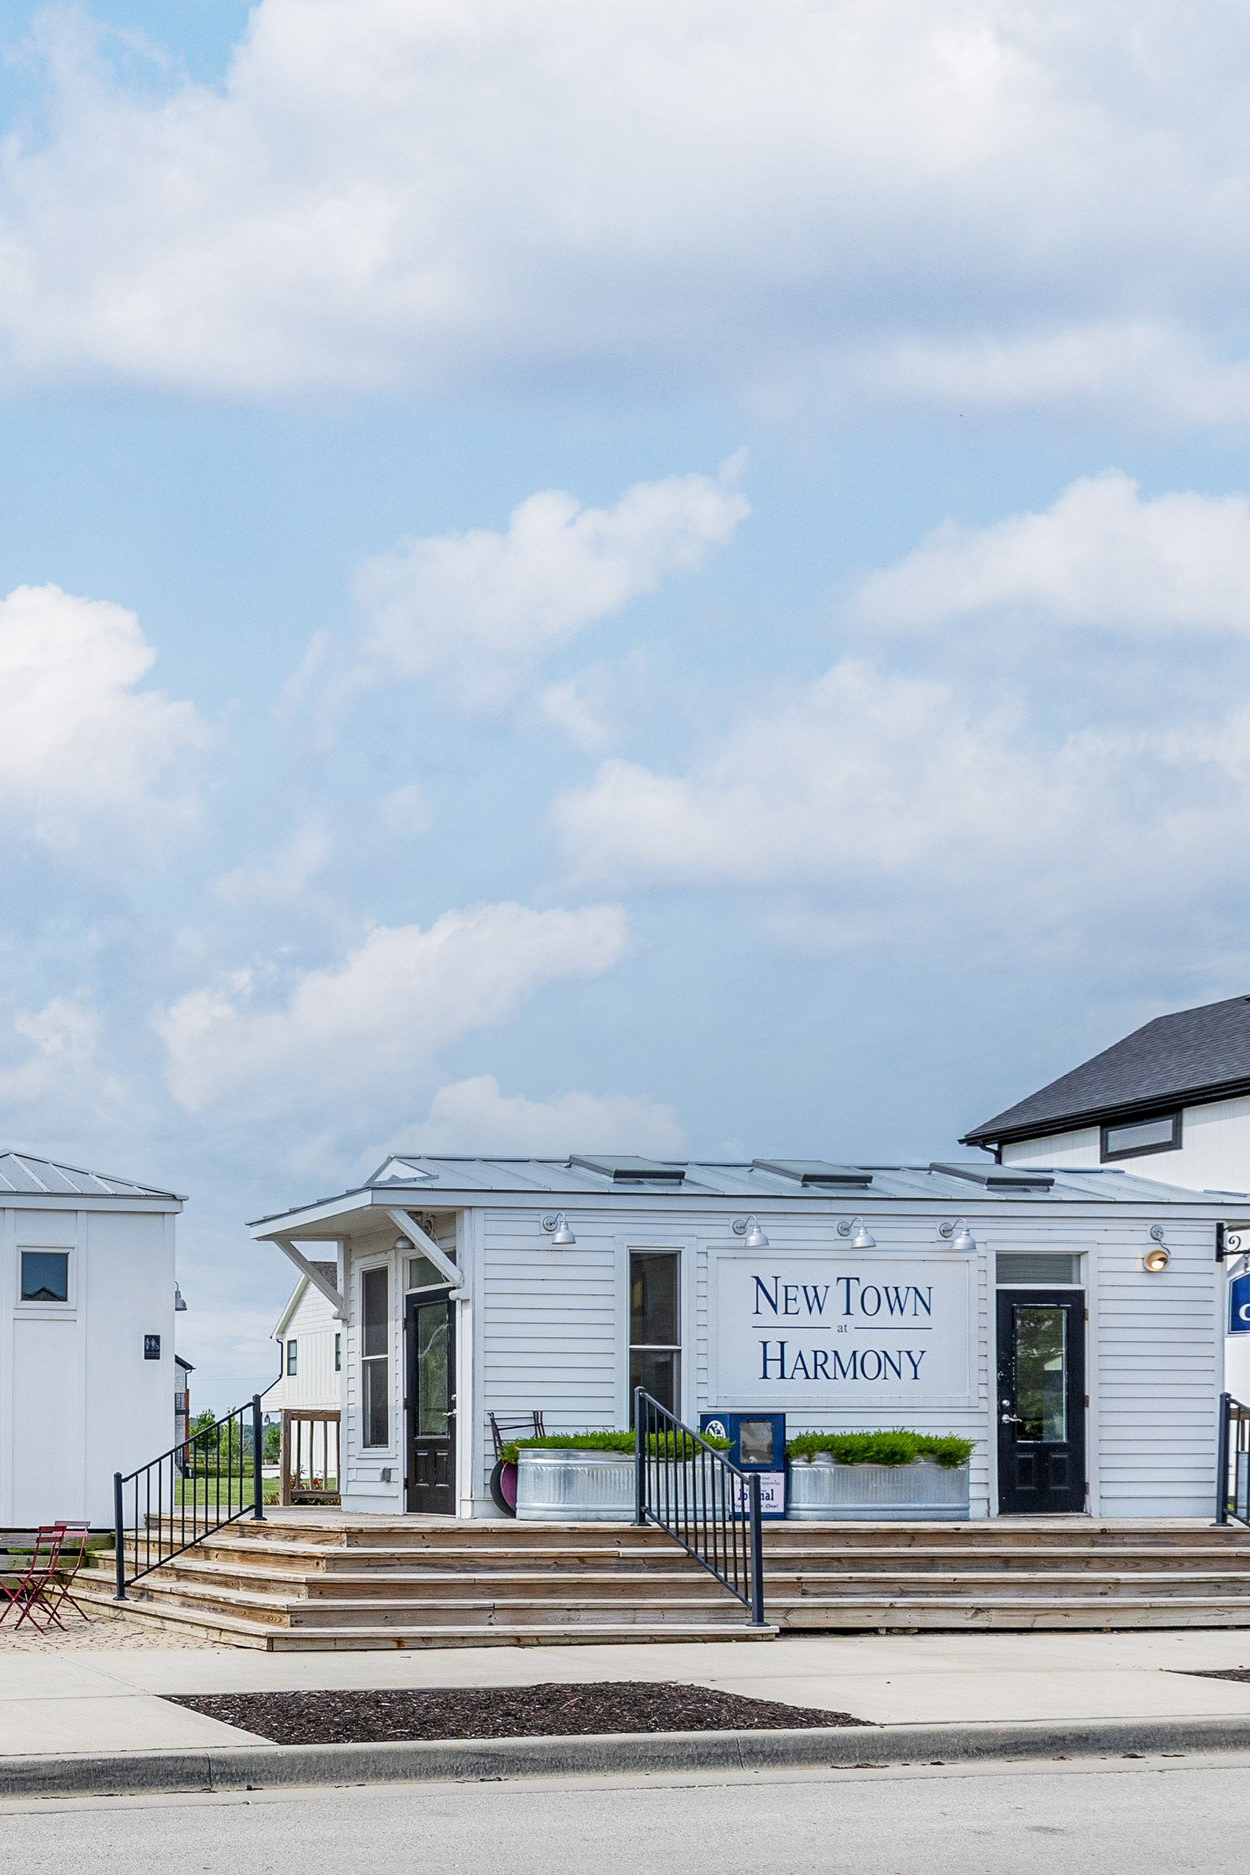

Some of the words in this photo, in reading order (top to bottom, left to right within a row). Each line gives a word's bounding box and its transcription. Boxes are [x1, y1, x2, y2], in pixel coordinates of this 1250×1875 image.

[750, 1275, 831, 1316] NEW
[836, 1276, 934, 1317] TOWN
[836, 1323, 848, 1333] at
[758, 1340, 927, 1381] HARMONY
